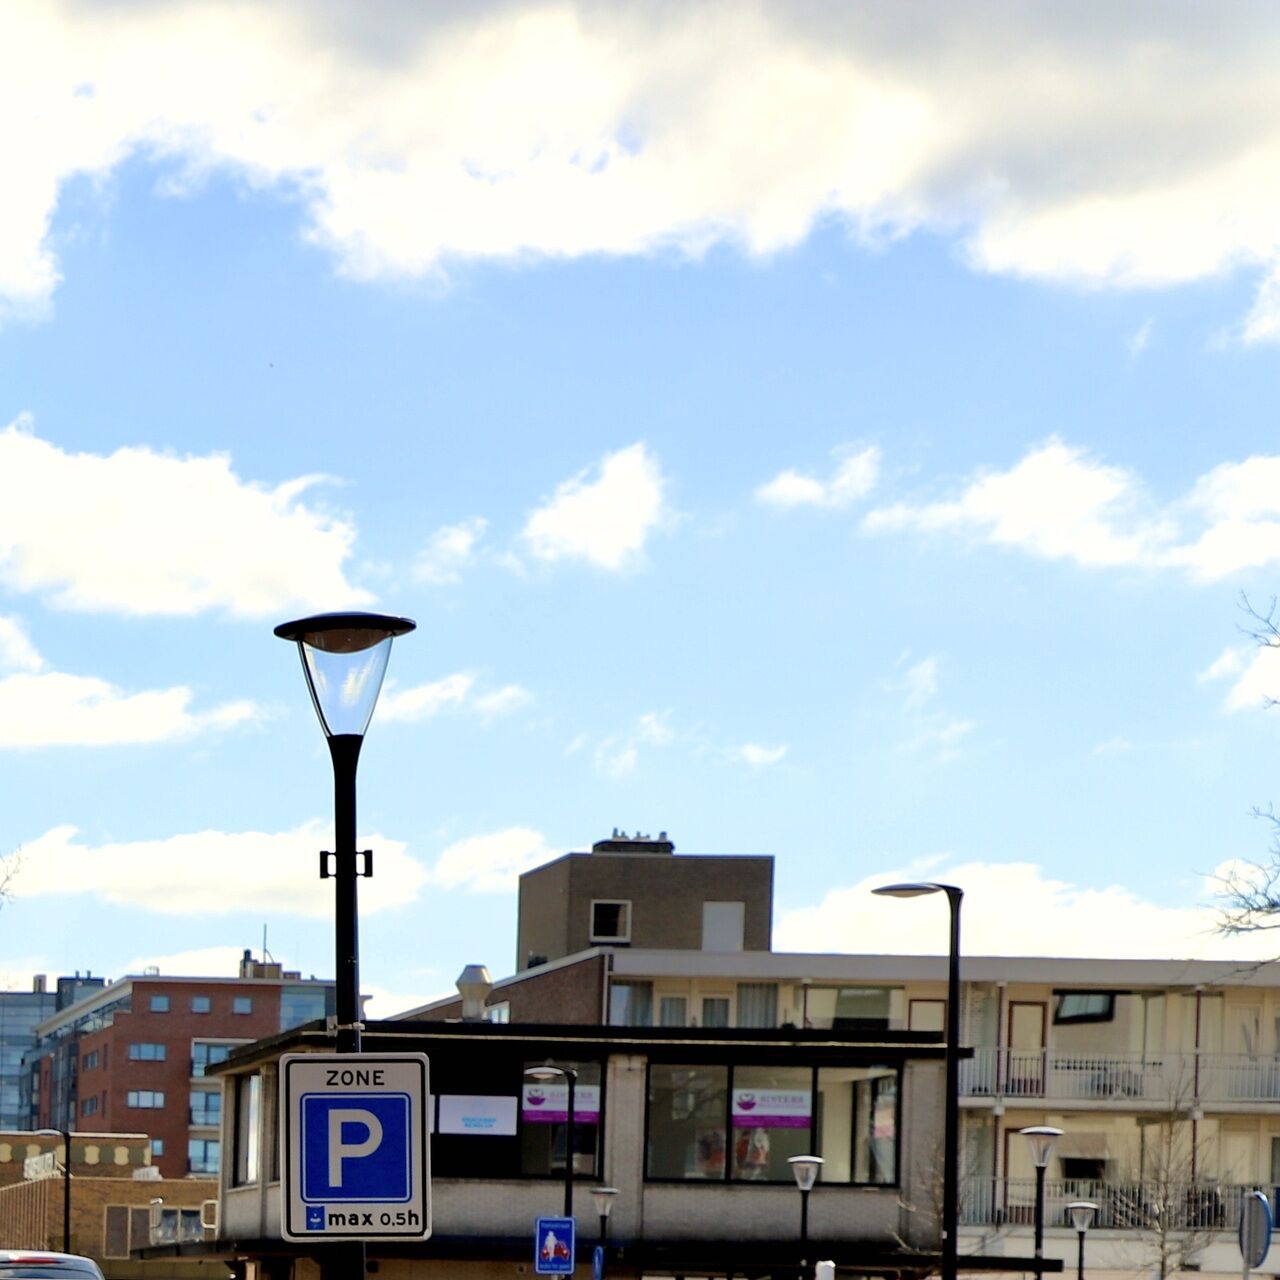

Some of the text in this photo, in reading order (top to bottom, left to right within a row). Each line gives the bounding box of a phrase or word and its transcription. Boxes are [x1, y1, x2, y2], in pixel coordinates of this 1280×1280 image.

[325, 1069, 385, 1087] ZONE
[328, 1109, 383, 1187] P
[327, 1212, 375, 1227] max
